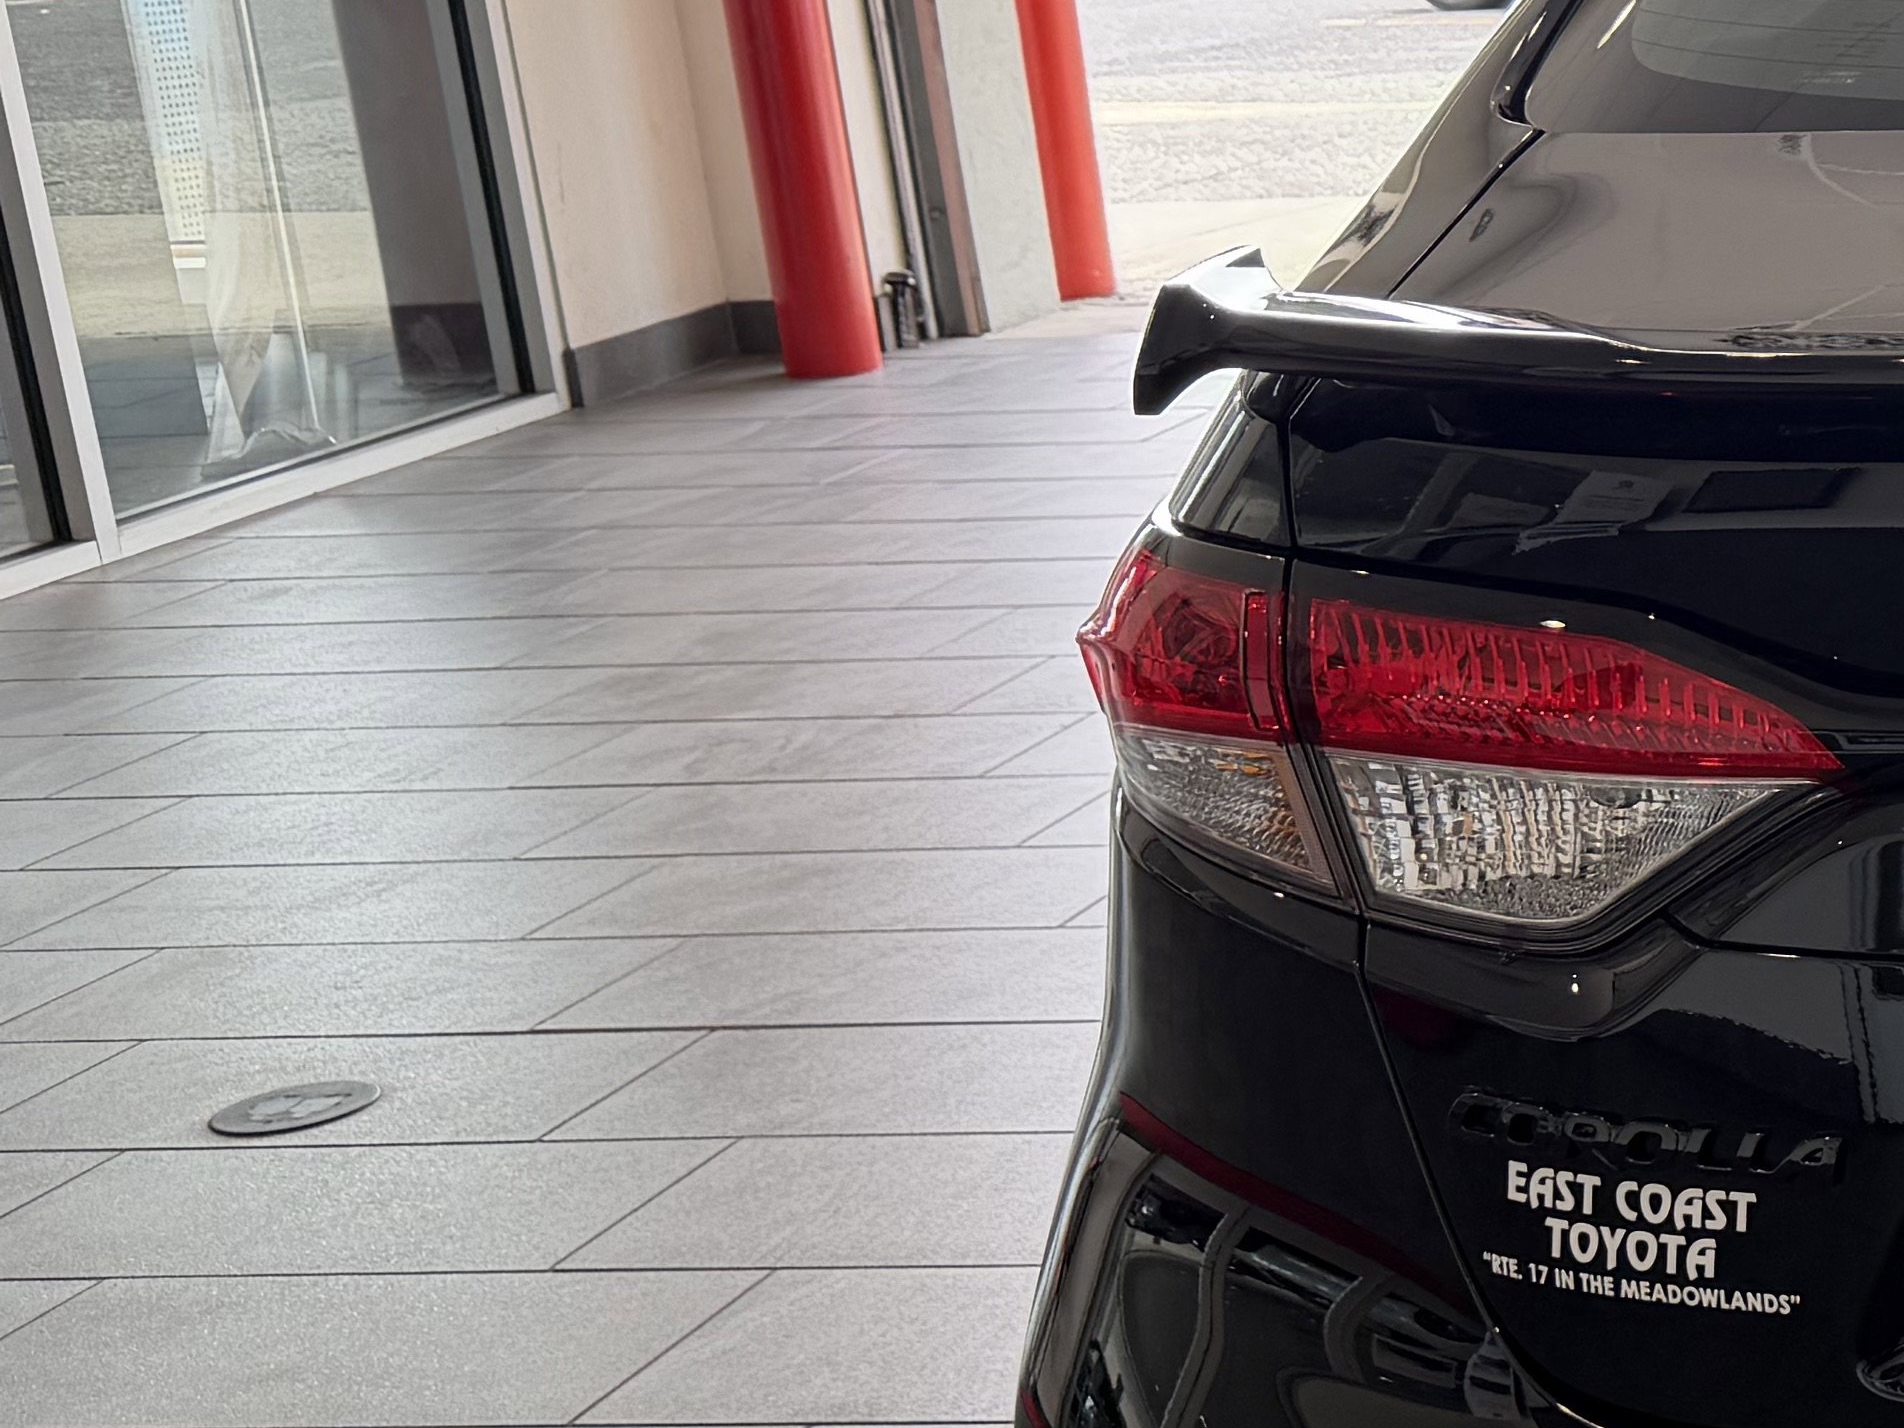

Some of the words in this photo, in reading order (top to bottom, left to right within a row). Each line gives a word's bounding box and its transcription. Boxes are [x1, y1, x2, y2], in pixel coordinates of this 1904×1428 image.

[1506, 1160, 1602, 1216] EAST
[1615, 1181, 1757, 1233] COAST
[1544, 1217, 1717, 1281] TOYOTA
[1528, 1263, 1548, 1285] 17
[1554, 1268, 1575, 1290] IN
[1579, 1272, 1615, 1298] THE
[1620, 1279, 1801, 1315] MEADOWLANDS"
